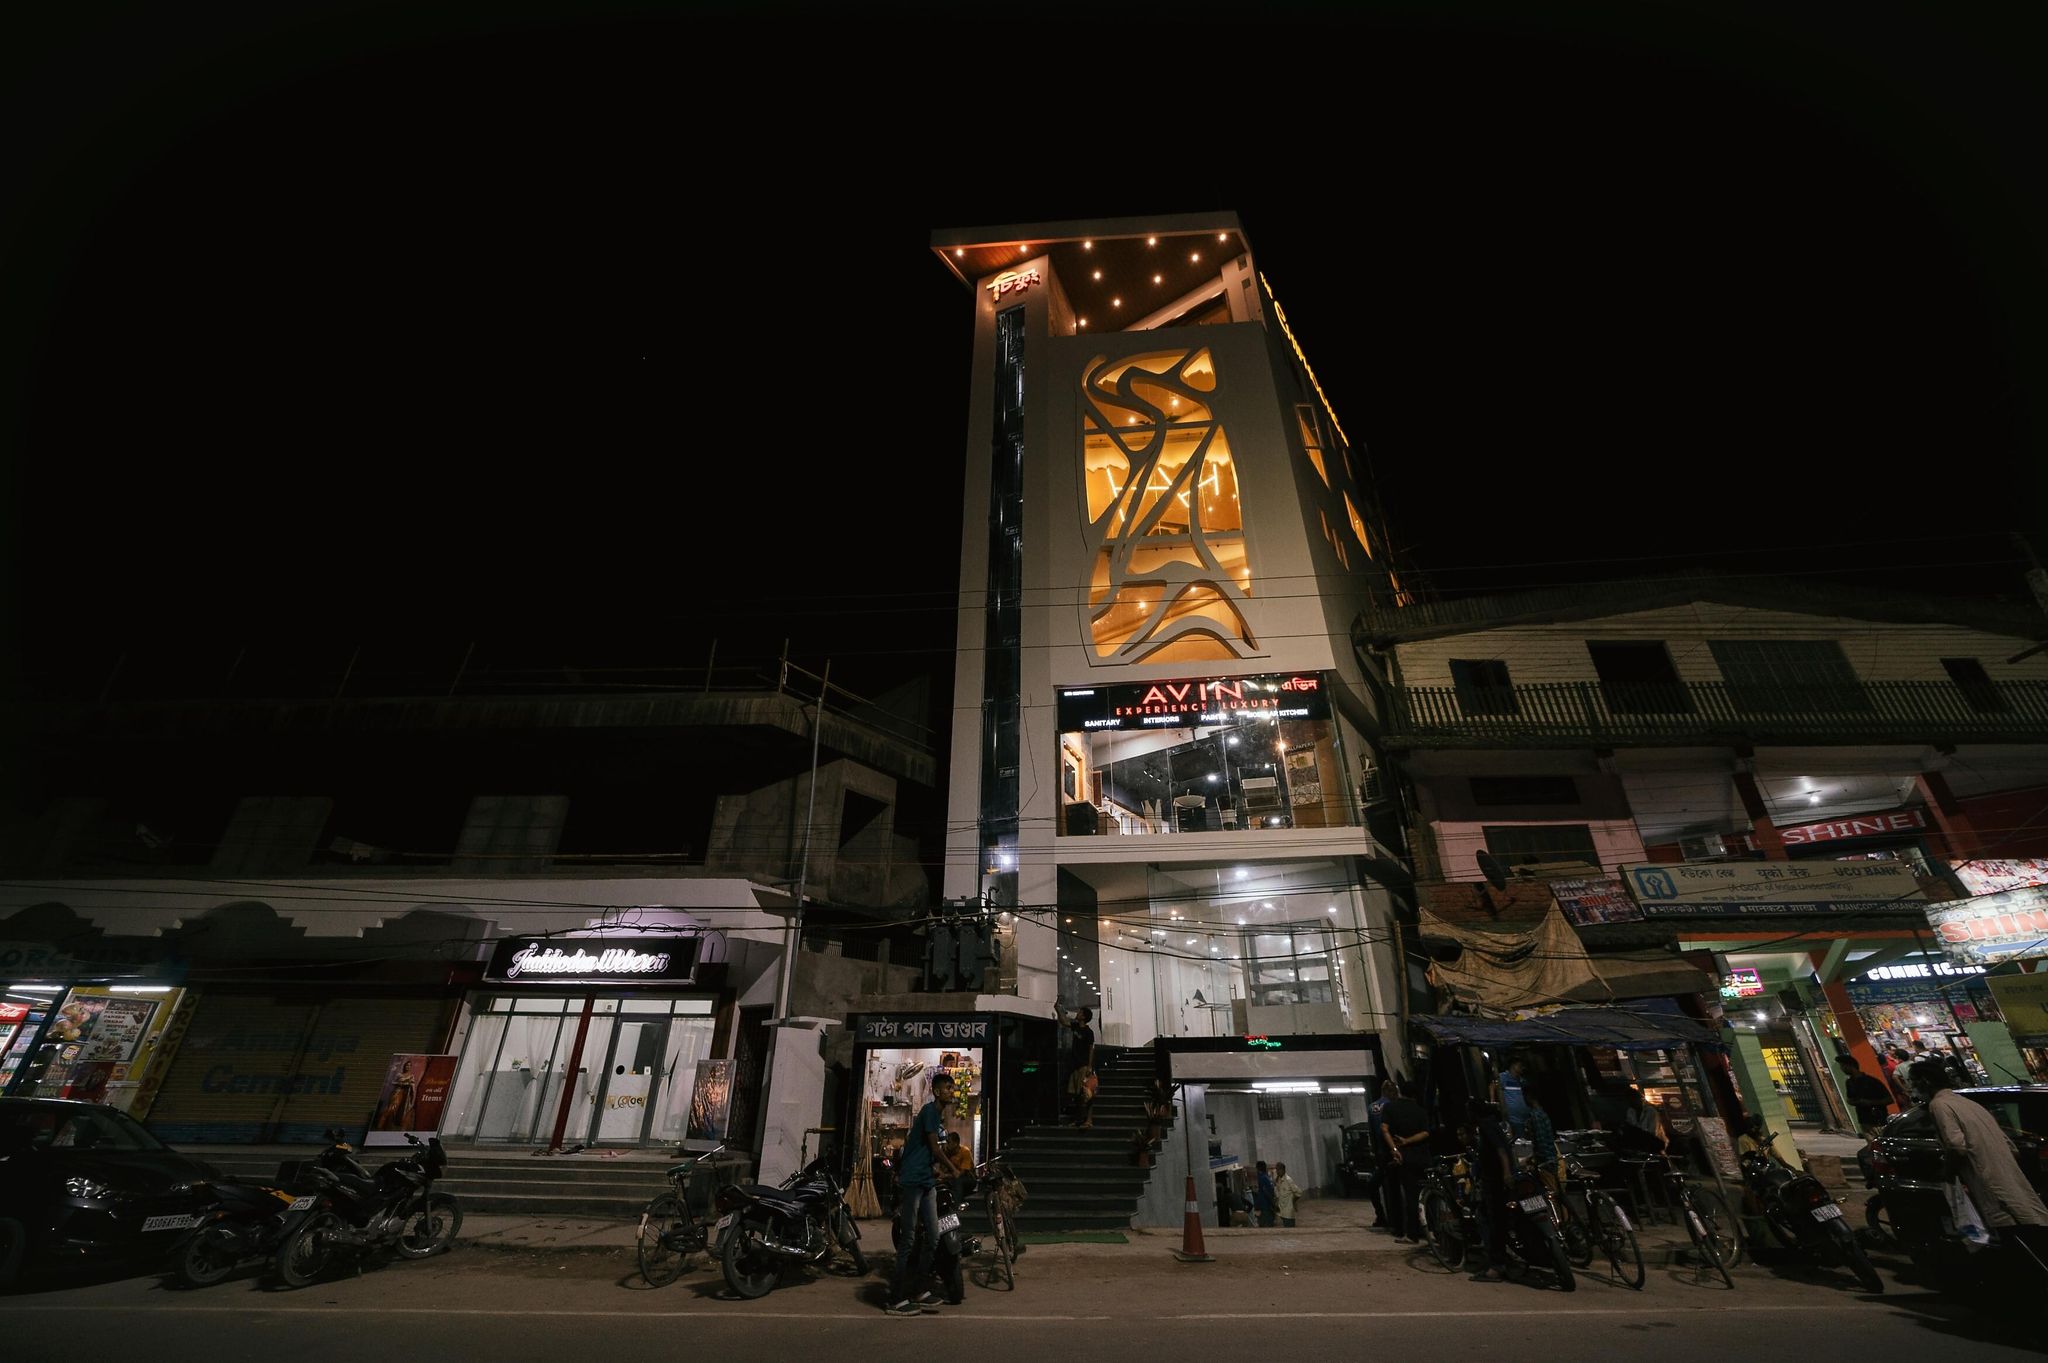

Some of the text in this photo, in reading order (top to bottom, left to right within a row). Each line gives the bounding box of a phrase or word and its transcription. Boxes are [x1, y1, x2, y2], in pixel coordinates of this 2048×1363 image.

[1142, 681, 1242, 705] AVIN
[1281, 677, 1317, 692] এভিন
[1116, 698, 1279, 716] EXPERIENCE LUXURY
[1085, 719, 1121, 727] SANITARY
[1143, 716, 1180, 724] INTERIORS
[1279, 708, 1308, 717] KITCHEN
[1833, 866, 1901, 876] UCO BANK
[866, 1016, 900, 1038] গগৈ
[903, 1021, 936, 1039] পান
[202, 1065, 346, 1094] Cement
